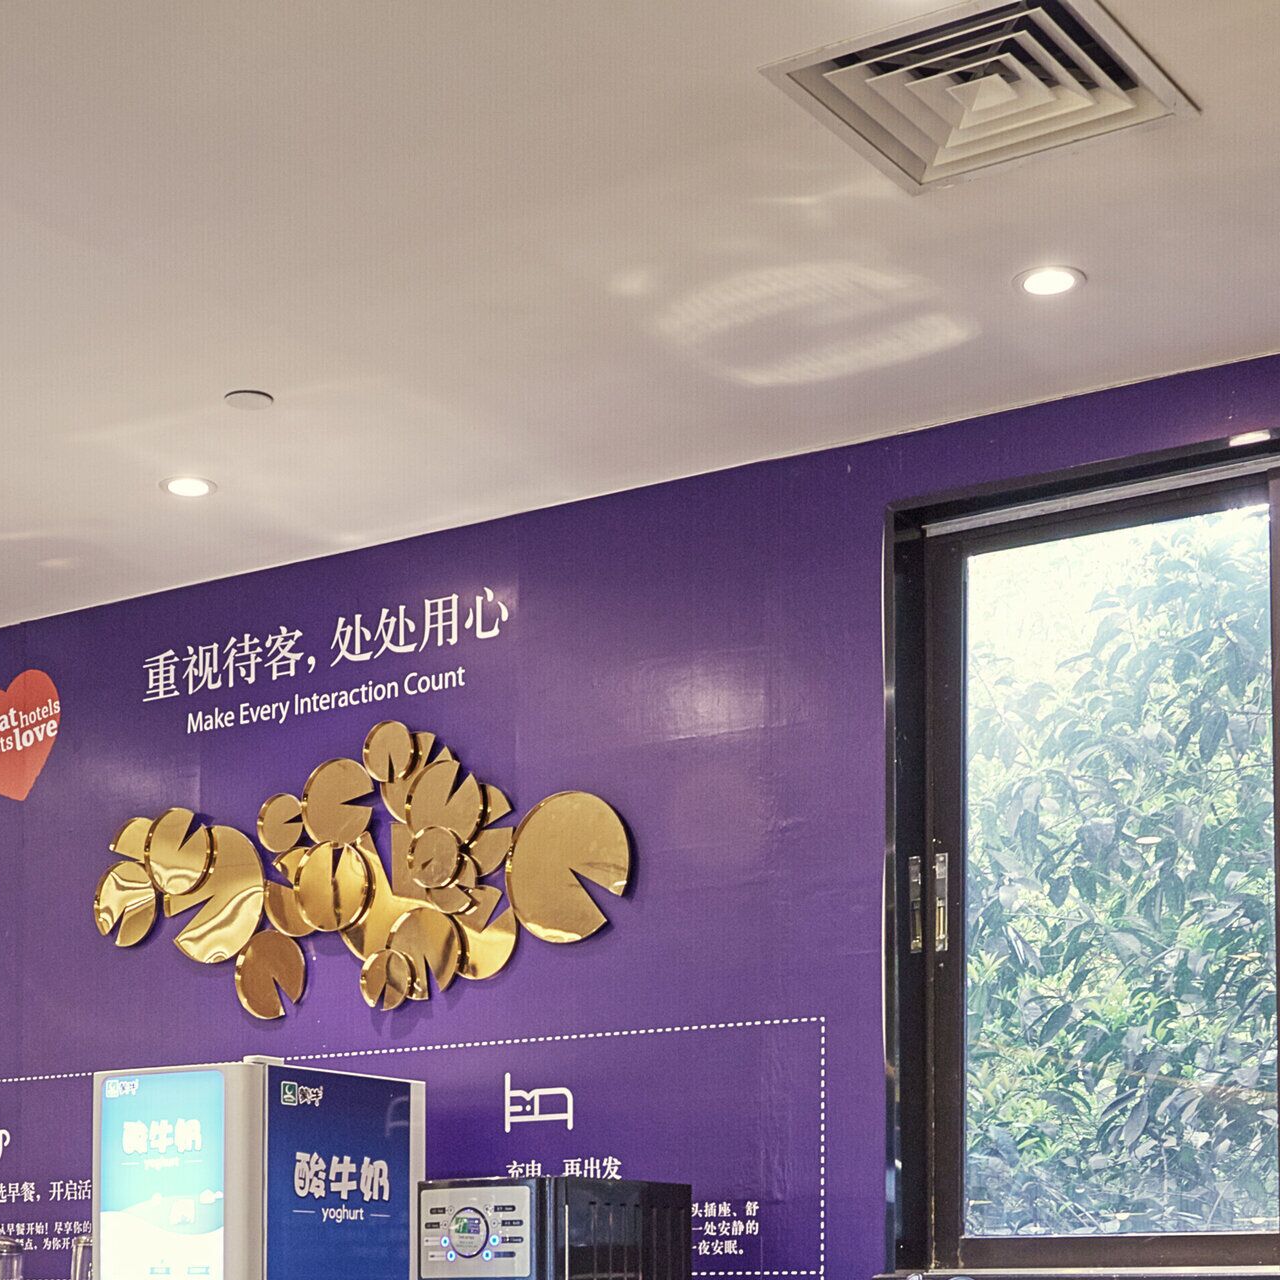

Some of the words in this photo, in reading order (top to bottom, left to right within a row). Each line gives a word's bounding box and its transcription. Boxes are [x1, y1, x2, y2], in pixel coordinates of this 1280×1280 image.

[142, 586, 509, 702] 重视待客，处处用心
[19, 699, 61, 728] hotels
[187, 707, 234, 733] Make
[240, 702, 290, 724] Every
[294, 681, 399, 715] Interaction
[404, 666, 466, 695] Count
[13, 719, 59, 751] love
[294, 1151, 390, 1202] 酸牛奶
[321, 1203, 365, 1224] yoghurt
